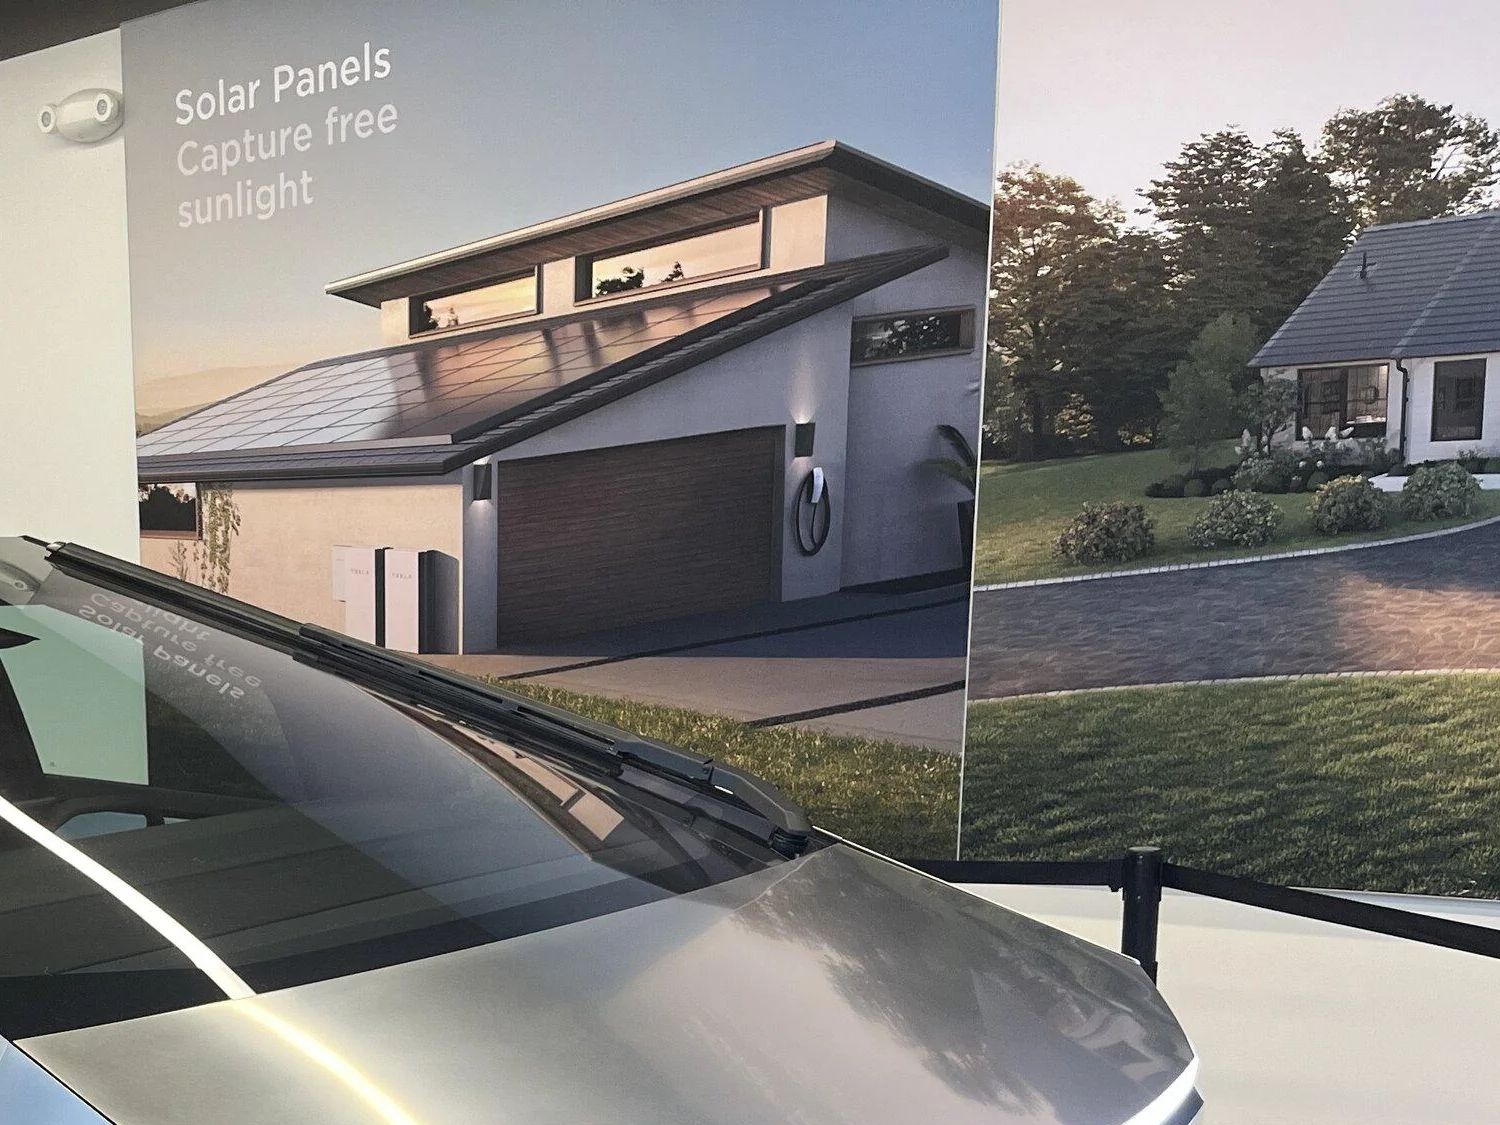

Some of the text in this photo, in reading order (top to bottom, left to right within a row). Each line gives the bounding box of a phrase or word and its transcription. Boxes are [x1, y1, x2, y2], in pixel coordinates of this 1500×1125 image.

[175, 41, 391, 125] Solar Panels
[177, 103, 398, 176] Capture free
[177, 170, 314, 228] sunlight
